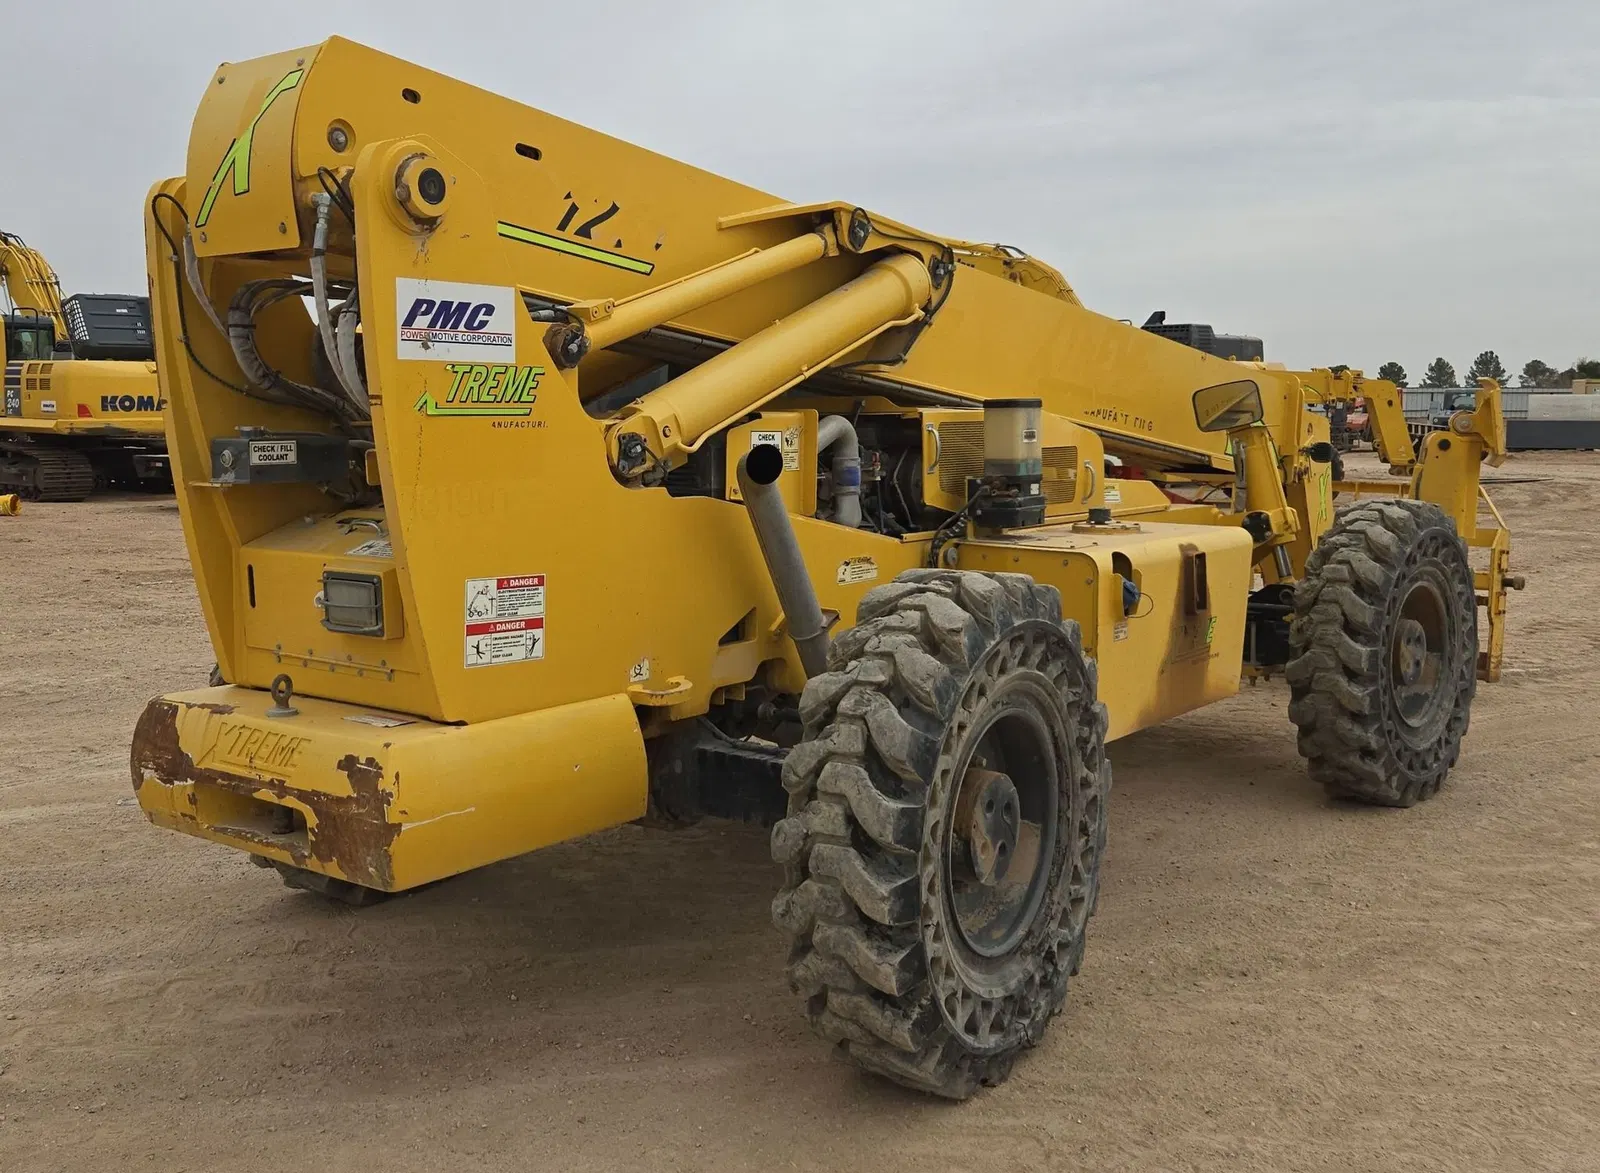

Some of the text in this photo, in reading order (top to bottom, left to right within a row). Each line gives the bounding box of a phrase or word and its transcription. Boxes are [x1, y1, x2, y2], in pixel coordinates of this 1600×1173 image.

[401, 298, 496, 331] PMC
[461, 333, 513, 344] CORPORATION
[7, 390, 14, 398] PC
[7, 399, 20, 408] 240
[253, 445, 276, 453] CHECK
[280, 444, 294, 452] FILL
[258, 453, 289, 461] COOLANT
[510, 577, 538, 587] DANGER
[496, 621, 525, 631] DANGER
[195, 721, 313, 769] XTREME
